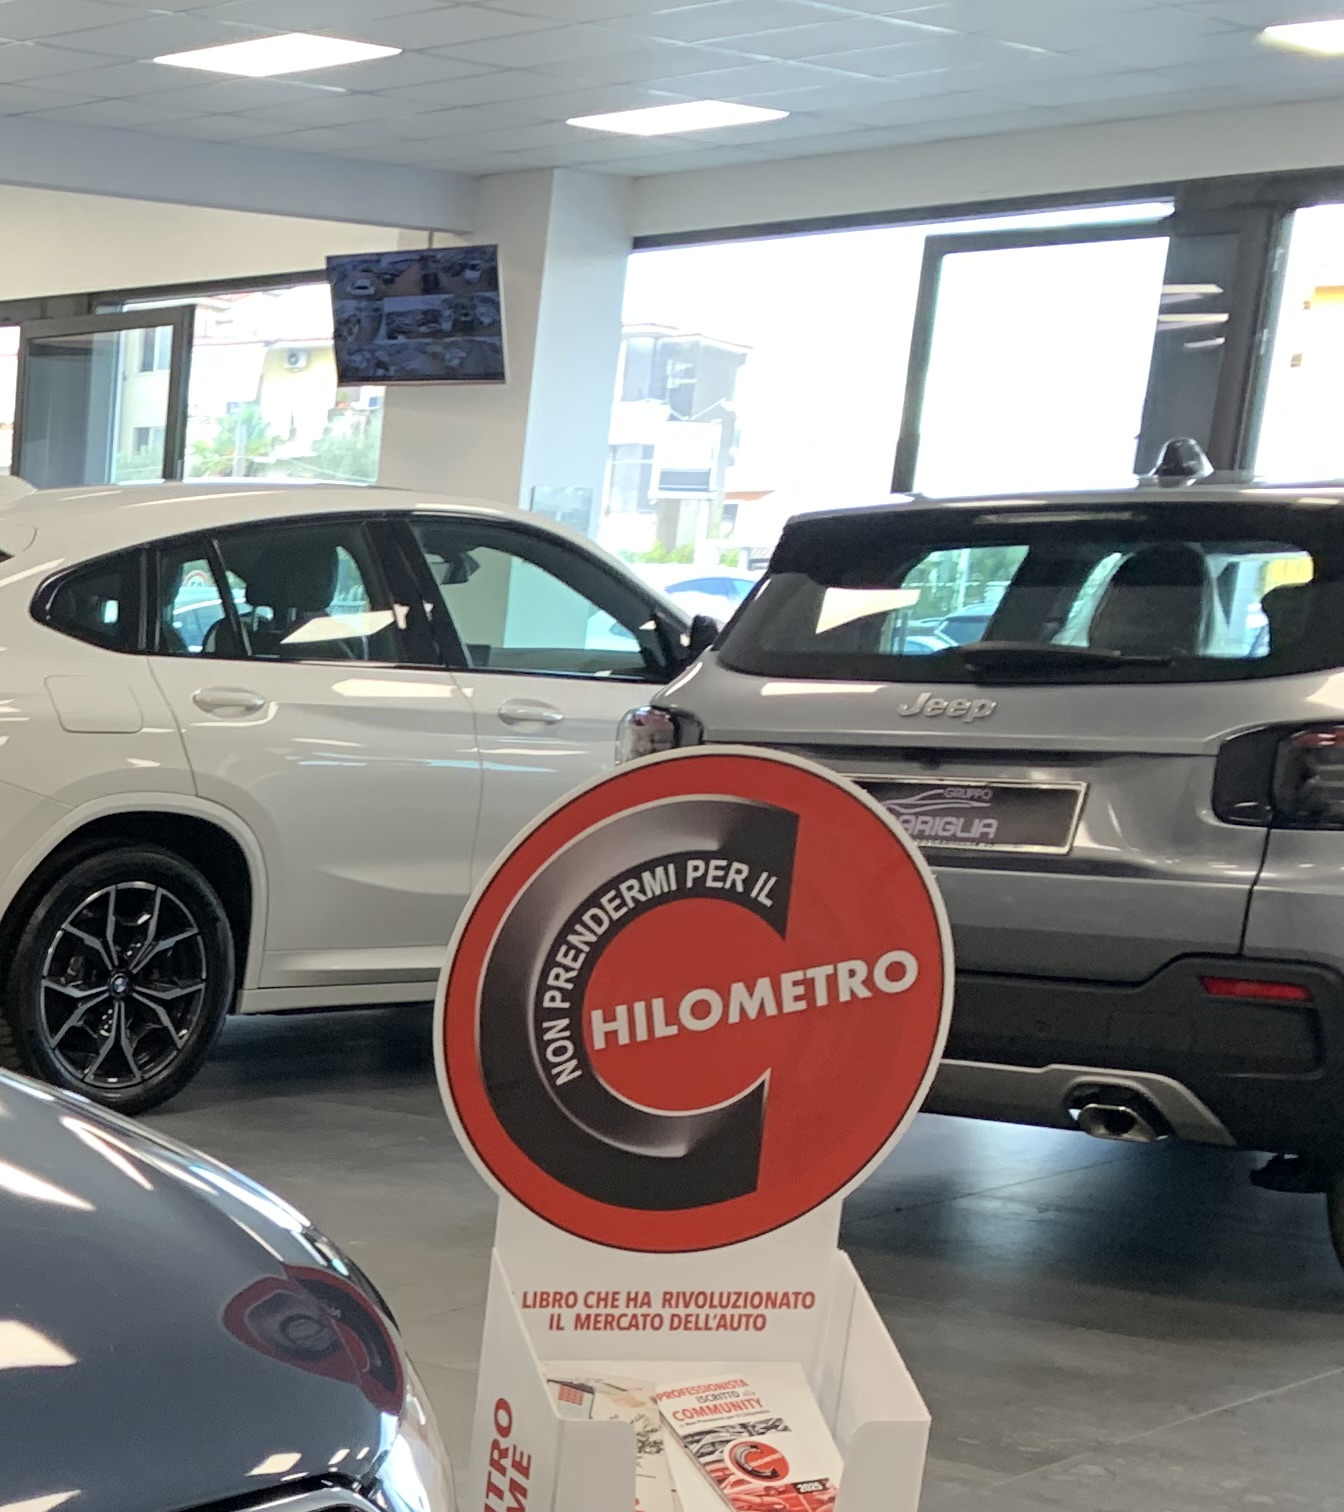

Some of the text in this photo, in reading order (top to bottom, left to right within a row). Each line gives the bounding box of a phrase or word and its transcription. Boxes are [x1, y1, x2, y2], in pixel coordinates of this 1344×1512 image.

[899, 693, 996, 722] Jeep
[944, 787, 993, 800] GRUPPO
[896, 814, 999, 840] ARIGLIA
[542, 858, 778, 1086] NON PRENDERMI PER IL
[522, 1290, 816, 1310] LIBRO CHE HA RIVOLUZIONATO
[548, 1312, 767, 1332] IL MERCATO DELL'AUTO
[655, 1378, 749, 1402] PROFESSIONISTA
[696, 1390, 740, 1404] ISCRITTO
[672, 1397, 763, 1422] COMMUNITY
